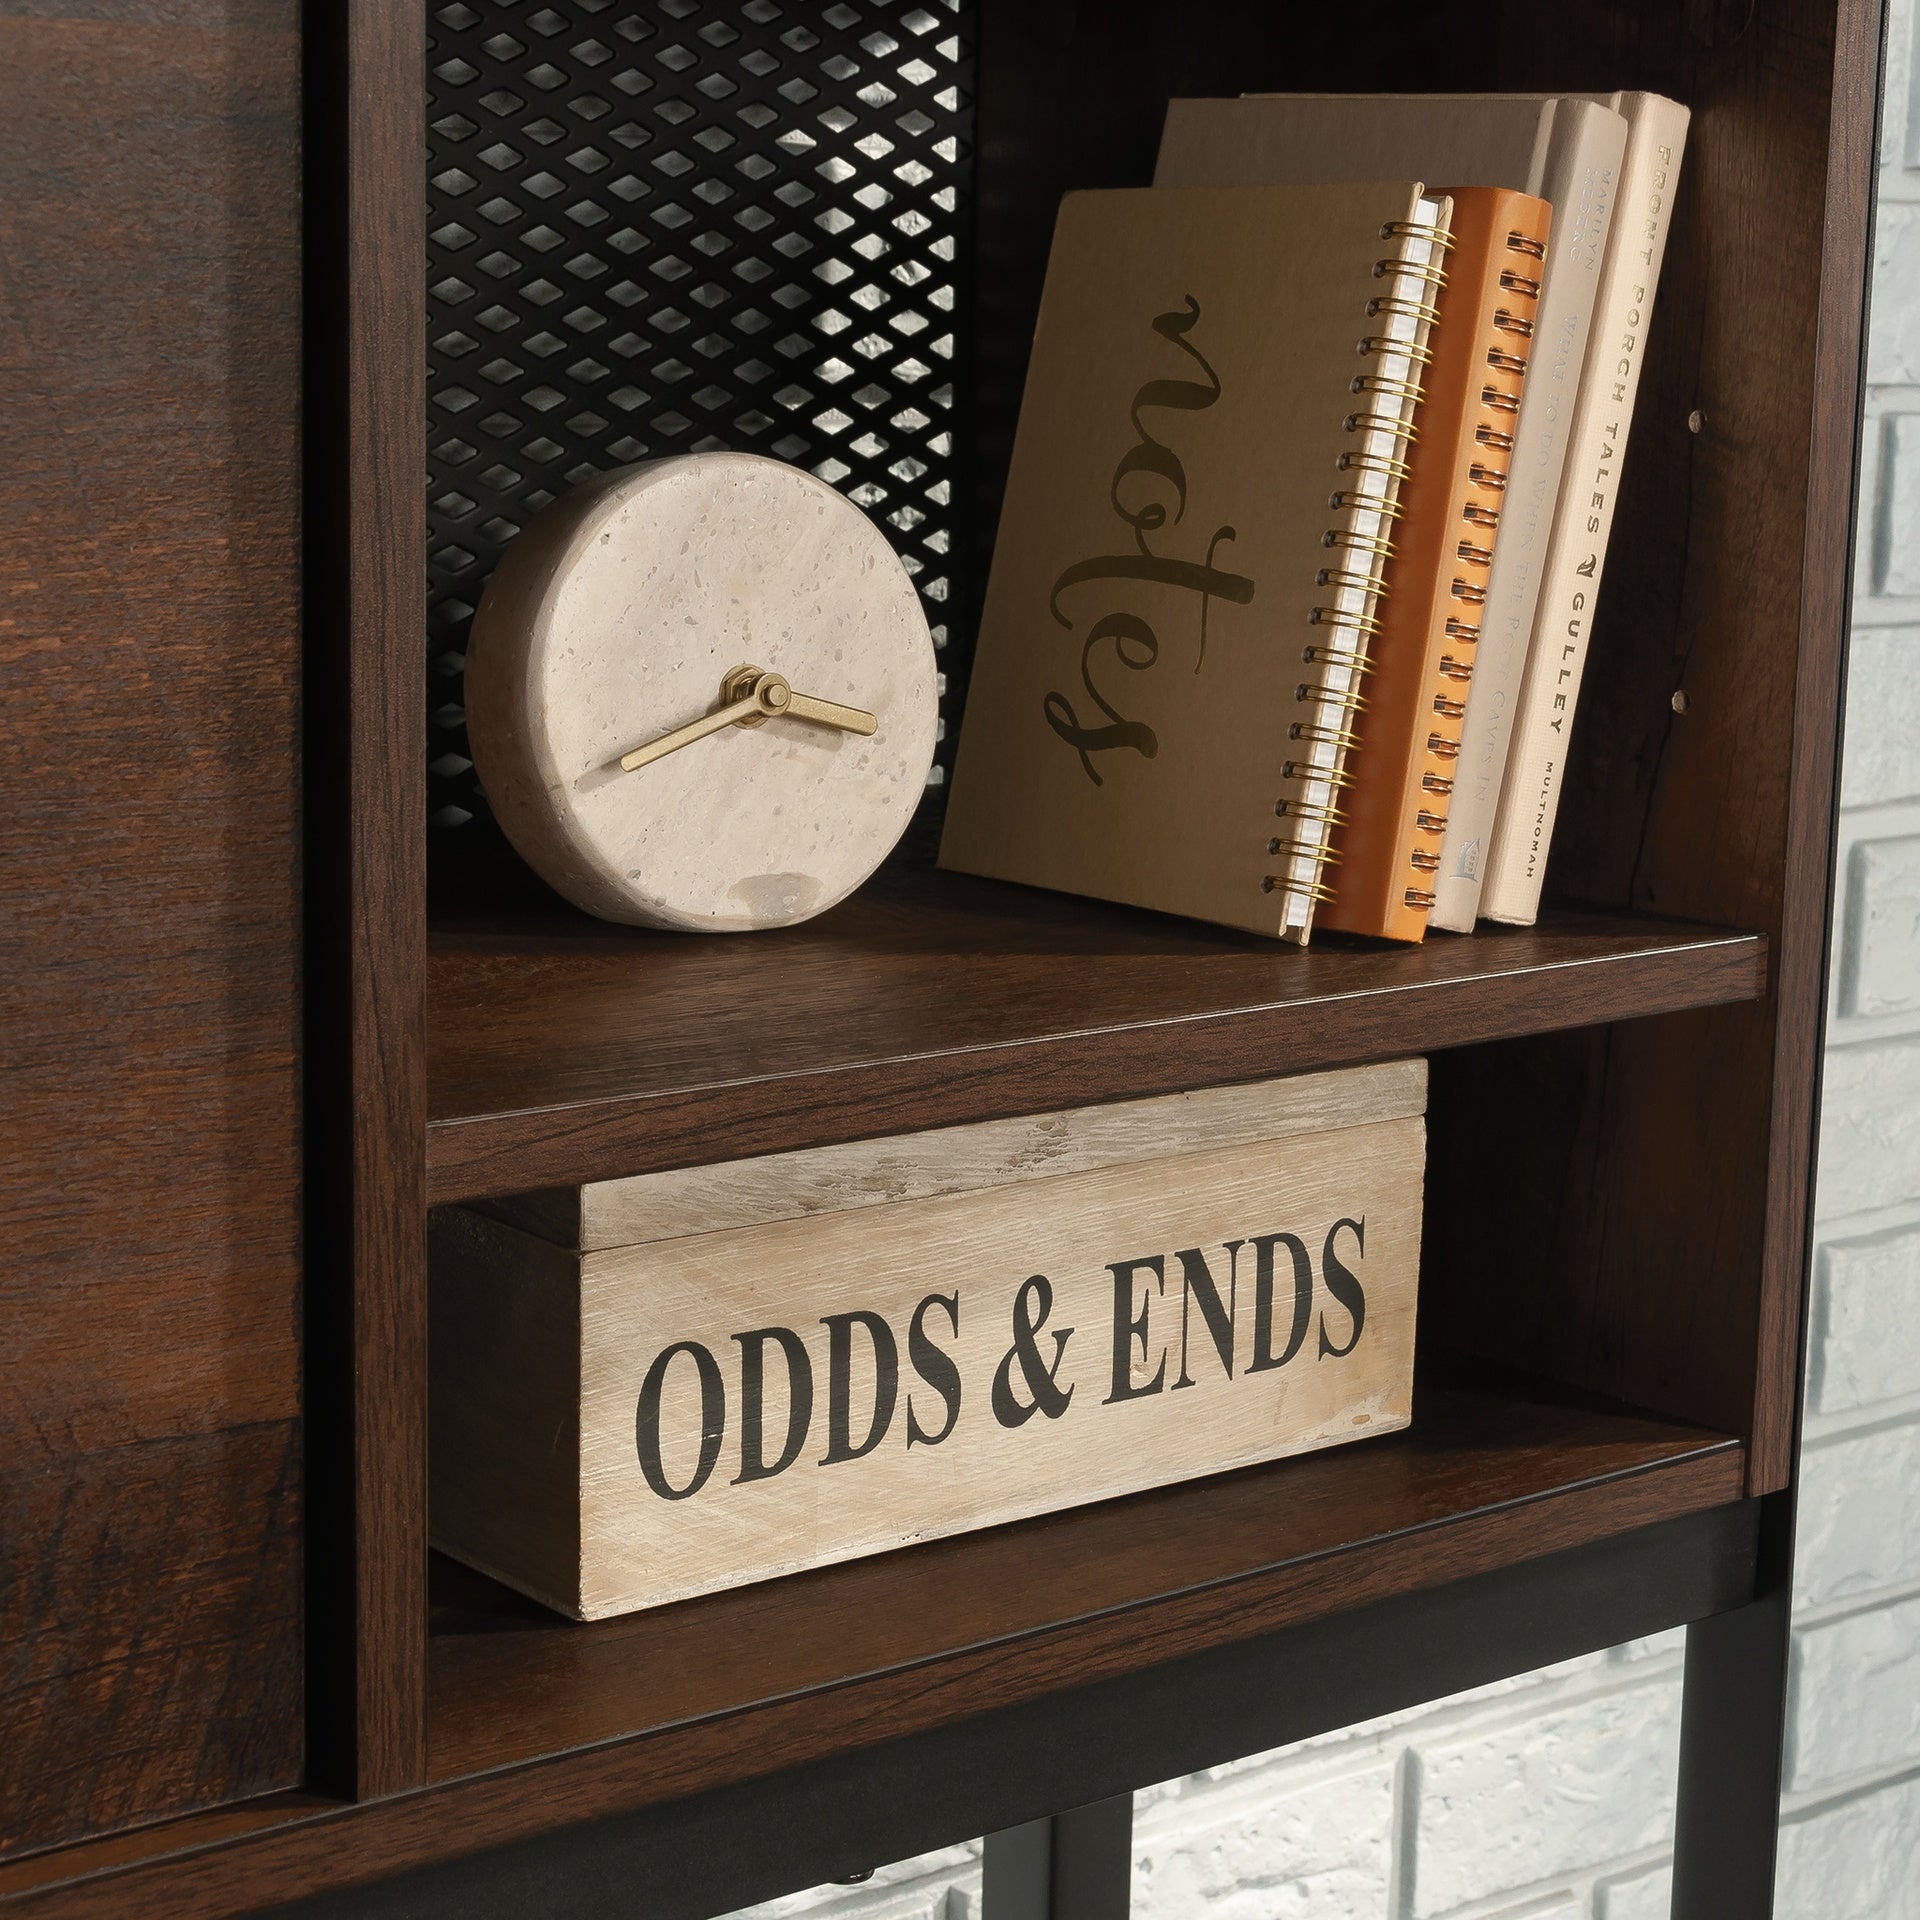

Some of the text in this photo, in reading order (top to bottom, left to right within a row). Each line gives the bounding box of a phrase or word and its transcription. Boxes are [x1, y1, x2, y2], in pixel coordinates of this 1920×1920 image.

[1584, 167, 1615, 272] MARILYN
[1551, 314, 1579, 384] WHAT
[1548, 144, 1672, 734] FRONT PORCH TALES GULLEY
[1043, 294, 1256, 787] notes
[1478, 690, 1506, 766] CAVES
[1525, 761, 1554, 879] MULTNOMAH
[635, 1214, 1367, 1501] ODDS & ENDS
